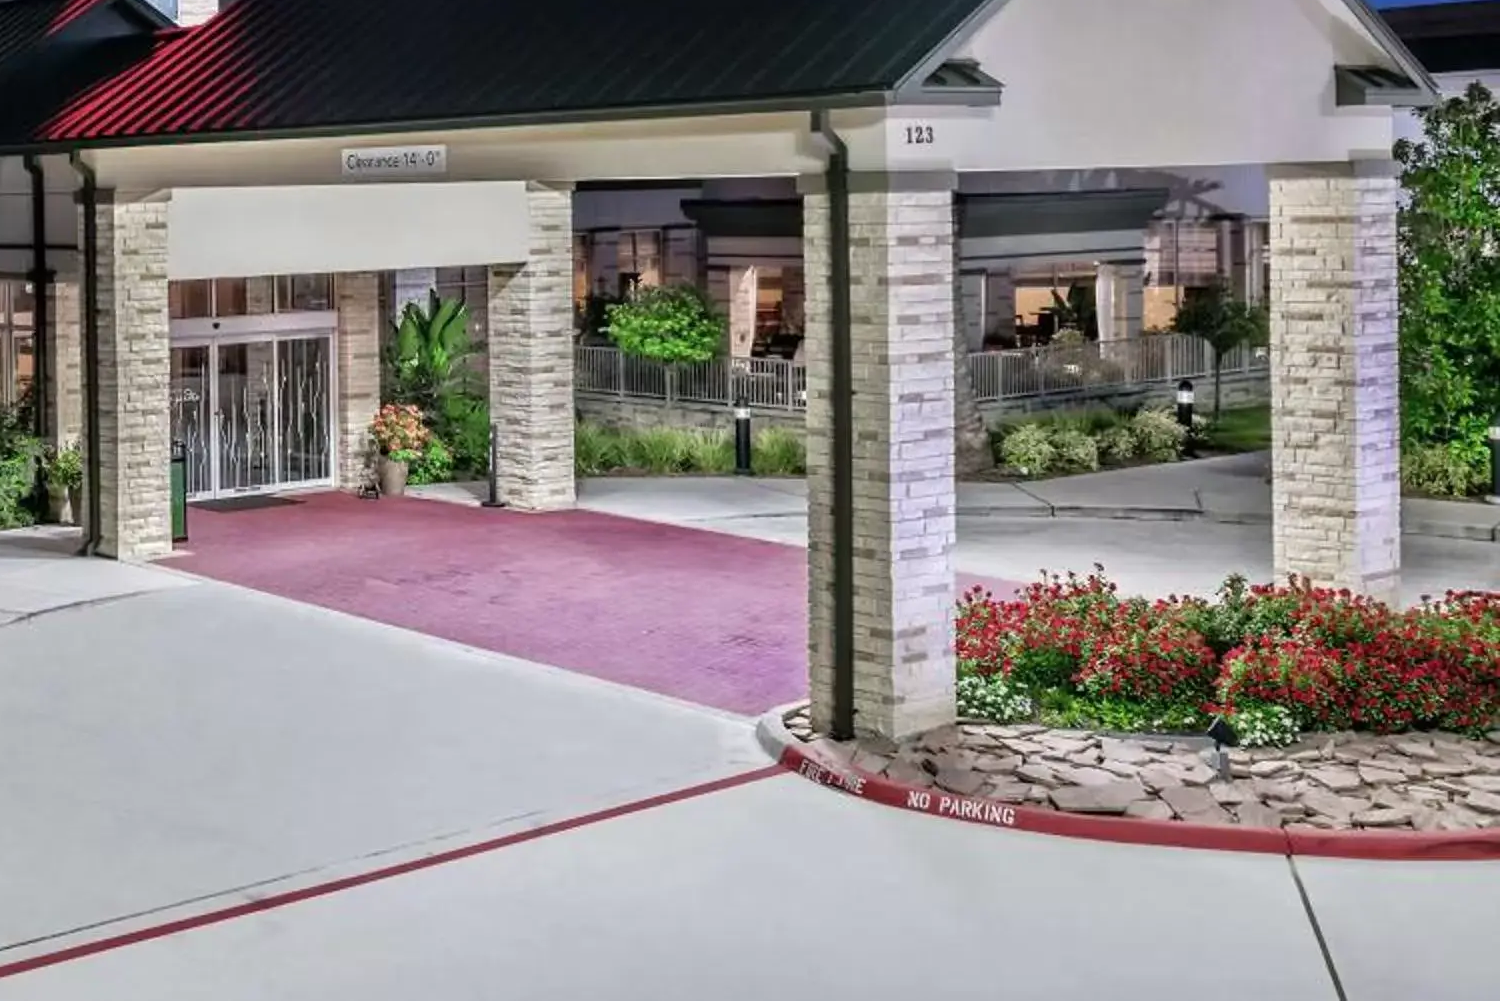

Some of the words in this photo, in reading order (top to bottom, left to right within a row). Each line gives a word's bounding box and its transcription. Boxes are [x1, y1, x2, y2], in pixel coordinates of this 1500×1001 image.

[906, 126, 934, 144] 123
[907, 790, 931, 809] NO
[938, 796, 1015, 826] PARKING
